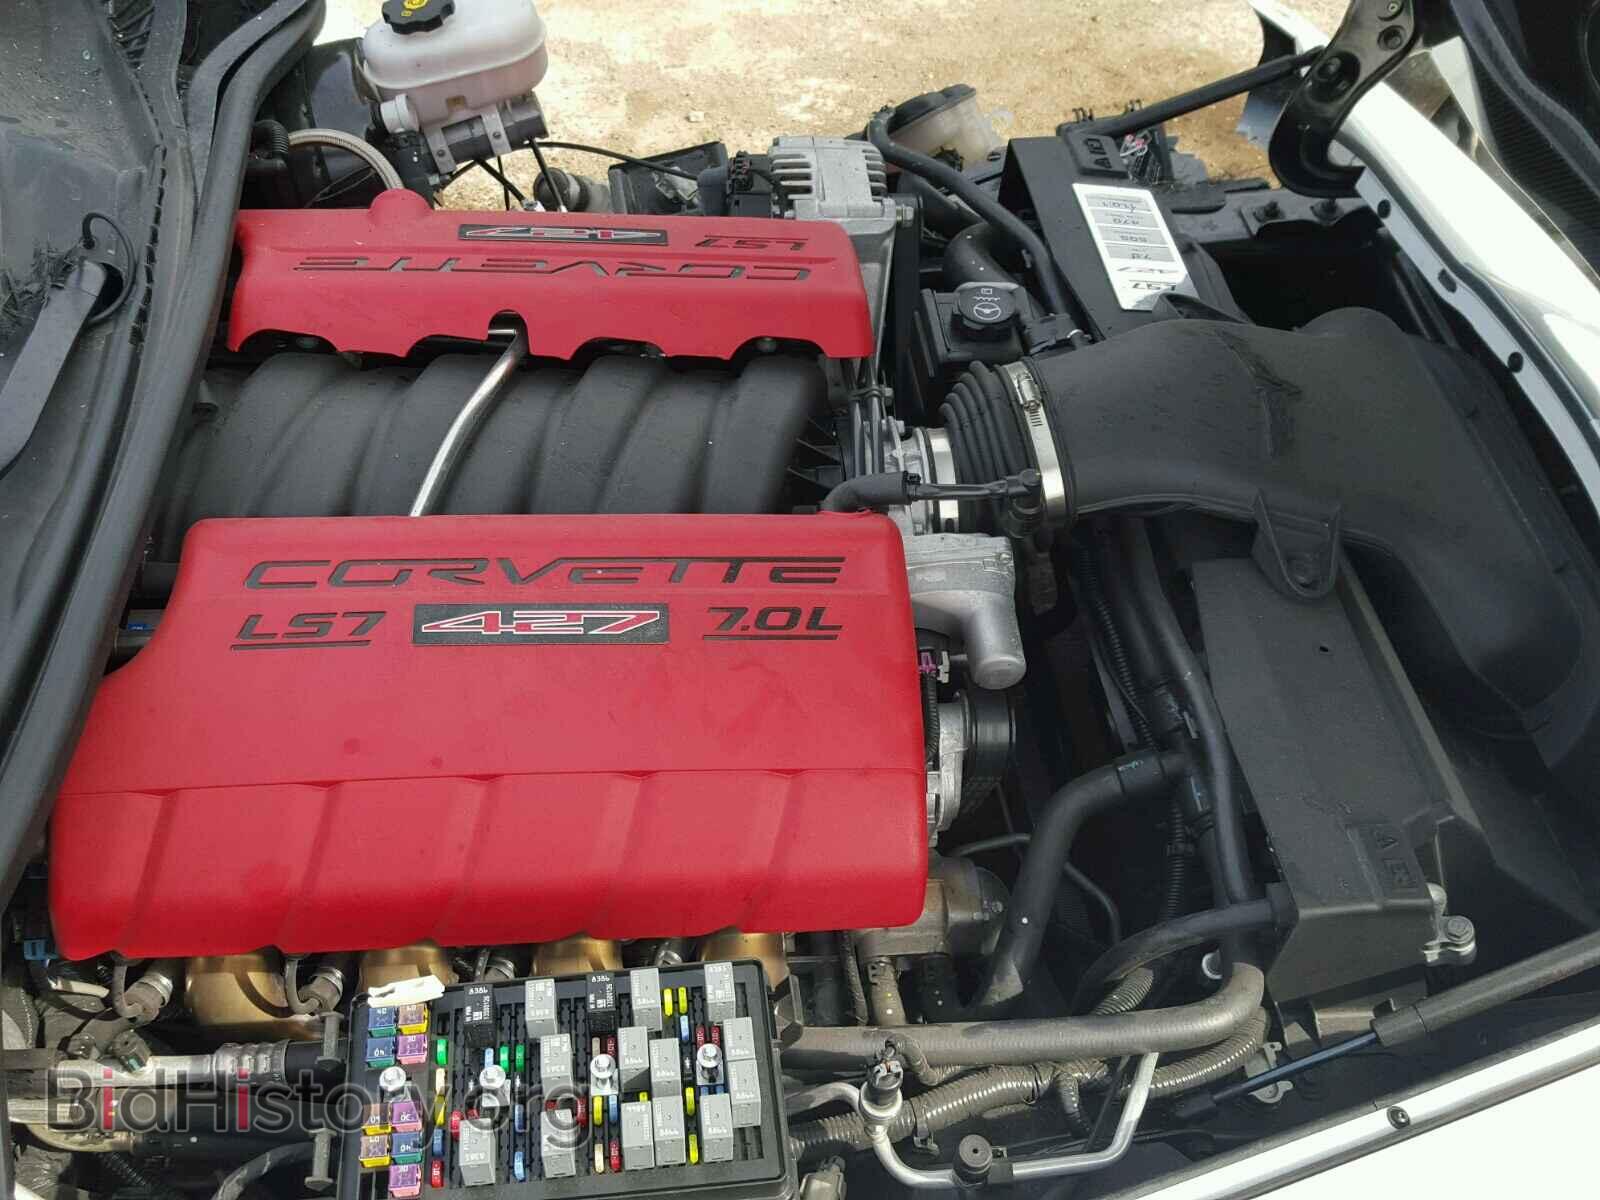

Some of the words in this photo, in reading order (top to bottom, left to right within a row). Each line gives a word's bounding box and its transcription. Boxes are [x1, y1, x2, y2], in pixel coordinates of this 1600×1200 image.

[695, 235, 808, 251] LS7
[293, 256, 811, 280] CORVETTE
[244, 556, 846, 589] CORVETTE
[236, 612, 387, 640] LS7
[421, 610, 660, 635] 427
[706, 606, 844, 632] 7.0L
